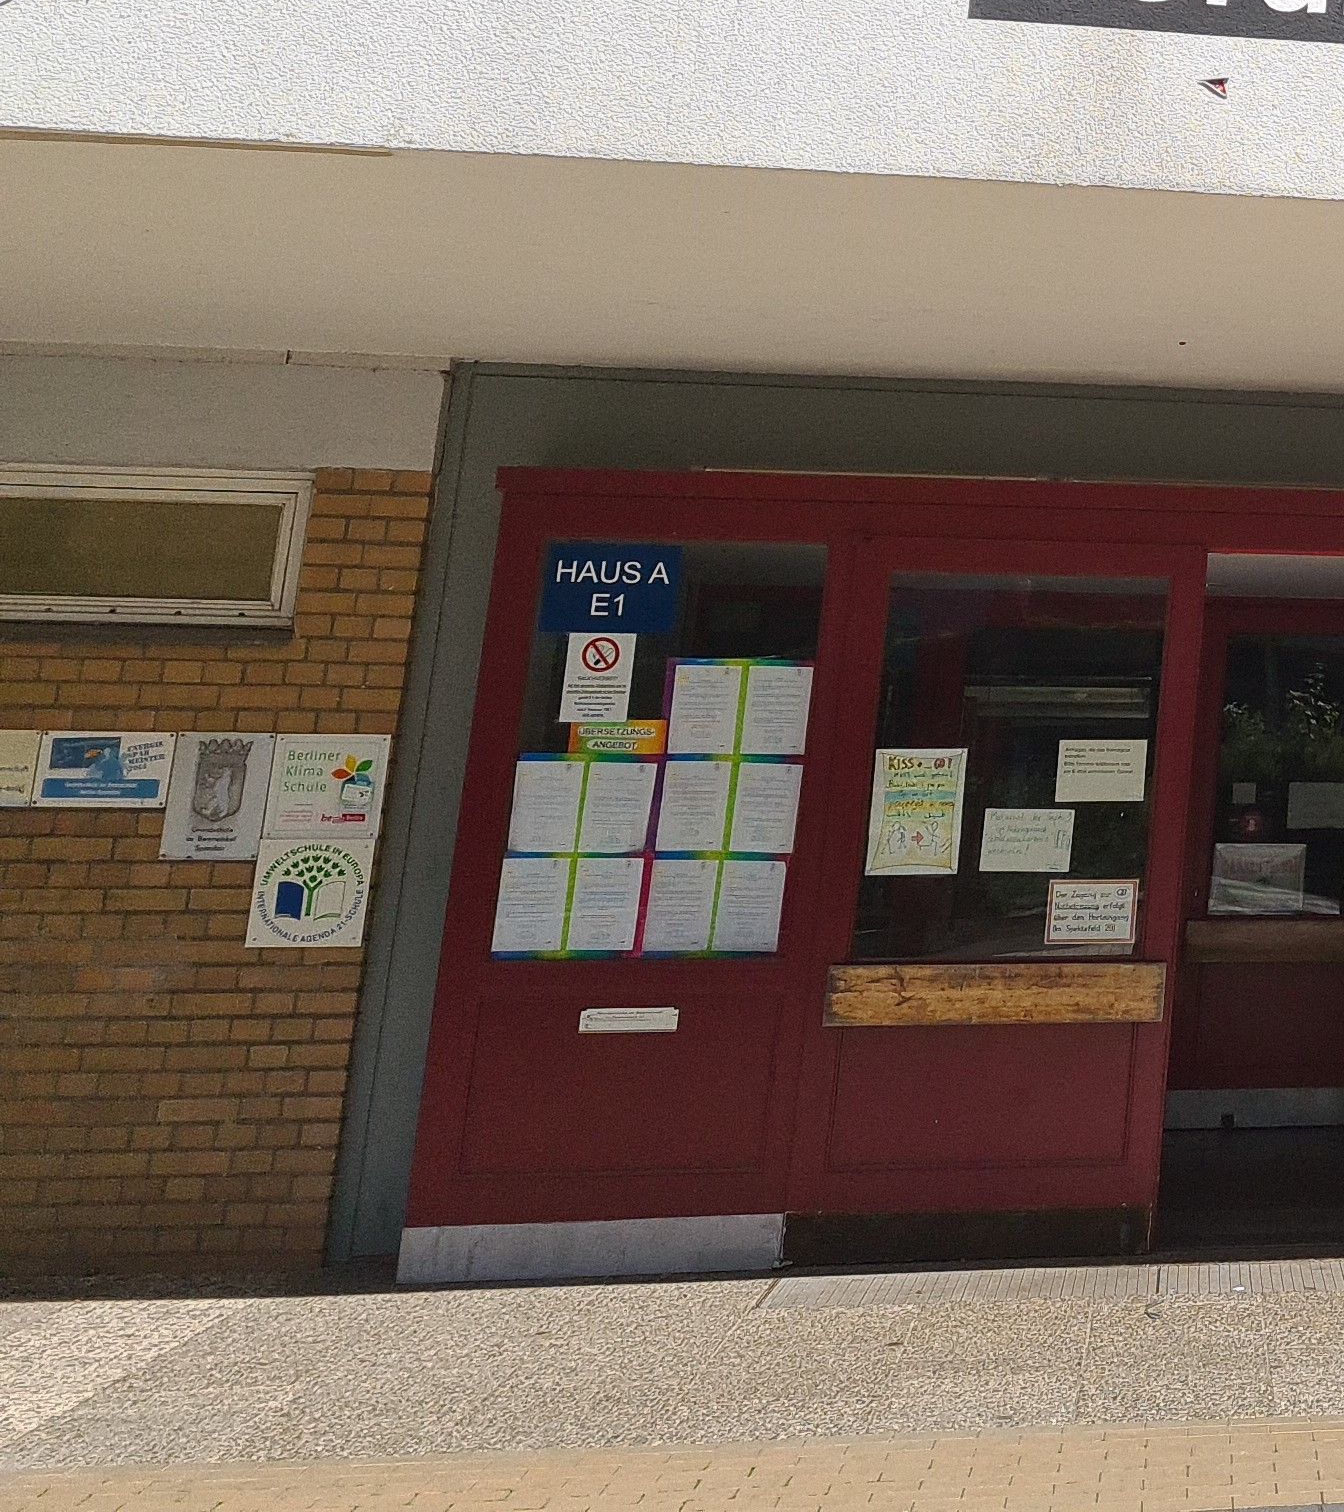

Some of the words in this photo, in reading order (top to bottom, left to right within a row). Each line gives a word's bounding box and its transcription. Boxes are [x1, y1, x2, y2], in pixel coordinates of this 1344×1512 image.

[556, 560, 641, 584] HAUS
[648, 561, 670, 585] A
[590, 593, 625, 617] E1
[287, 750, 341, 762] Berliner
[285, 765, 324, 777] Klima
[283, 781, 327, 792] Schule
[260, 843, 331, 886] UMWELTSCHULE
[332, 847, 343, 856] IN
[342, 853, 366, 886] EUROPA
[257, 890, 299, 943] INTERNATIONALE
[300, 928, 337, 943] AGENDA
